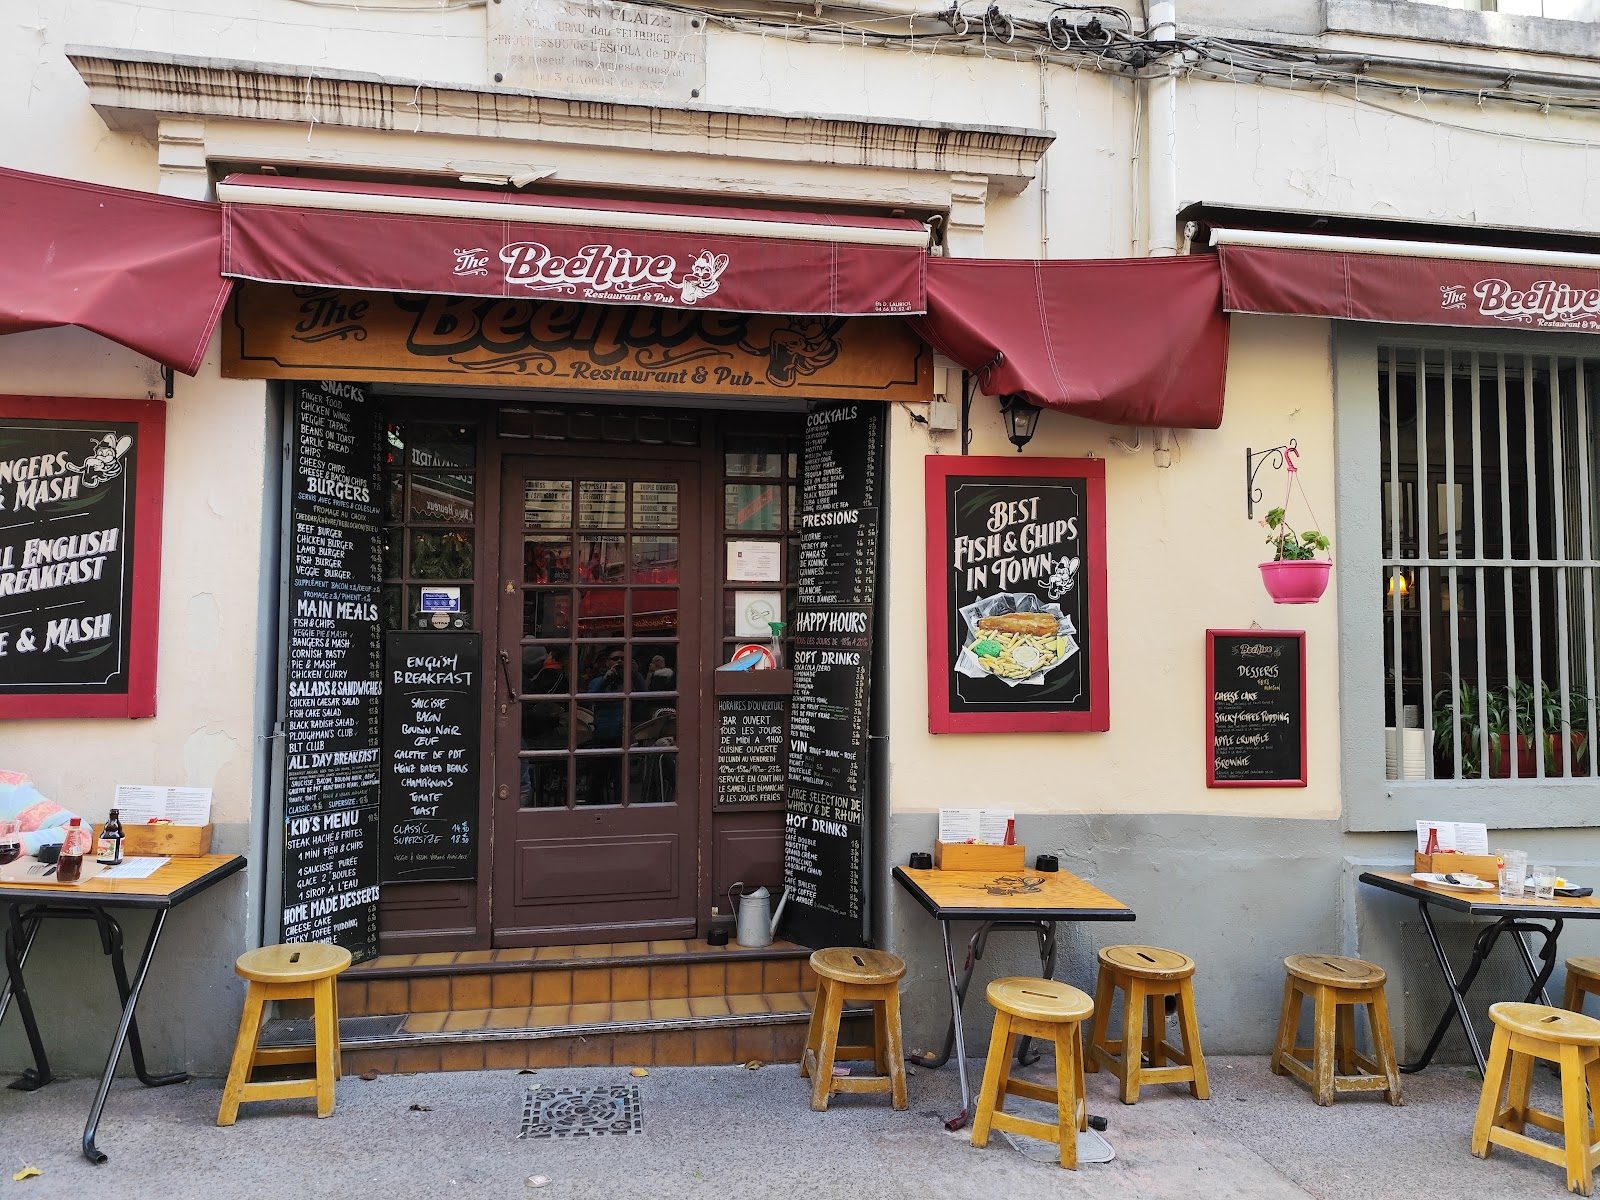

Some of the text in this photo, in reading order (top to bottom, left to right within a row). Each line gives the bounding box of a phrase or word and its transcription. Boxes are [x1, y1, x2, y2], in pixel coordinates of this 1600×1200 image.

[453, 242, 678, 289] The Beehive
[583, 288, 675, 304] Restaurant & Pub
[1442, 279, 1600, 320] The Beehive
[295, 298, 369, 333] The
[1537, 318, 1581, 328] Restaurant
[570, 361, 753, 387] Restaurant & Pub
[320, 380, 364, 402] SNACKS
[301, 389, 342, 409] FINGER FOOD
[301, 412, 347, 432] VEGGIE TAPAS
[807, 405, 857, 427] COCKTAILS
[301, 424, 356, 445] BEANS ON TOAST
[300, 456, 345, 474] CHEESY CHIPS
[13, 475, 80, 513] MASH
[307, 477, 370, 503] BURGERS
[802, 510, 859, 528] PRESSIONS
[987, 496, 1040, 533] BEST
[297, 523, 342, 538] BEEF BURGER
[22, 527, 120, 571] ENGLISH
[297, 534, 353, 550] CHICKEN BURGER
[954, 516, 1078, 572] FISH & CHIPS
[296, 565, 351, 579] VEGGIE BURGER
[966, 551, 1052, 592] IN TOWN
[298, 599, 379, 621] MAIN MEALS
[796, 611, 867, 633] HAPPY HOURS
[15, 612, 112, 653] & MASH
[291, 649, 346, 659] CORNISH PASTY
[795, 650, 860, 665] SOFT DRINKS
[407, 653, 458, 671] ENGLISH
[394, 671, 472, 686] BREAKFAST
[1237, 665, 1279, 678] DESSERTS
[289, 680, 382, 697] SALADS & SANDWICHES
[411, 698, 449, 709] SAUCISSE
[1215, 690, 1258, 704] CHEESE CAKE
[290, 708, 342, 718] FISH CAKE SALAD
[719, 701, 784, 711] HORAIRES D'OUVERTURE
[416, 711, 441, 722] BACON
[723, 716, 771, 725] BAR OUVERT
[402, 724, 461, 736] BOUDIN NOIR
[720, 726, 782, 735] TOUS LES JOURS
[289, 741, 324, 753] BLT CLUB
[721, 736, 783, 744] DE MIDI 1H00
[790, 739, 808, 753] VIN
[1214, 732, 1270, 747] APPLE CRUMBLE
[394, 749, 445, 759] GALETTE DE
[719, 745, 778, 753] CUISINE OUVERTE
[289, 749, 378, 770] ALL DAY BREAKFAST
[726, 755, 740, 763] LUNDI
[750, 755, 776, 763] VENDREDI
[1215, 755, 1251, 771] BROWNIE
[394, 763, 468, 774] HEINZ BAKED BEANS
[401, 776, 453, 788] CHAMPIGNONS
[718, 774, 784, 783] SERVICE EN CONTINU
[757, 784, 784, 792] DIMANCHE
[409, 792, 443, 802] TOMATE
[720, 794, 725, 802] &
[739, 794, 759, 802] JOURS
[760, 793, 781, 801] FÉRIÉS
[788, 787, 861, 812] LARGE SELECTION DE
[410, 806, 439, 816] TOAST
[787, 800, 861, 824] WHISKY & DE RHUM
[291, 810, 359, 836] KID'S MENU
[393, 823, 429, 834] CLASSIC
[786, 813, 848, 838] HOT DRINKS
[287, 828, 363, 849] STEAK HACHÉ & FRITES
[393, 834, 443, 845] SUPERSIZE
[797, 888, 817, 898] COFFEE
[284, 885, 380, 926] HOME MADE DESSERTS
